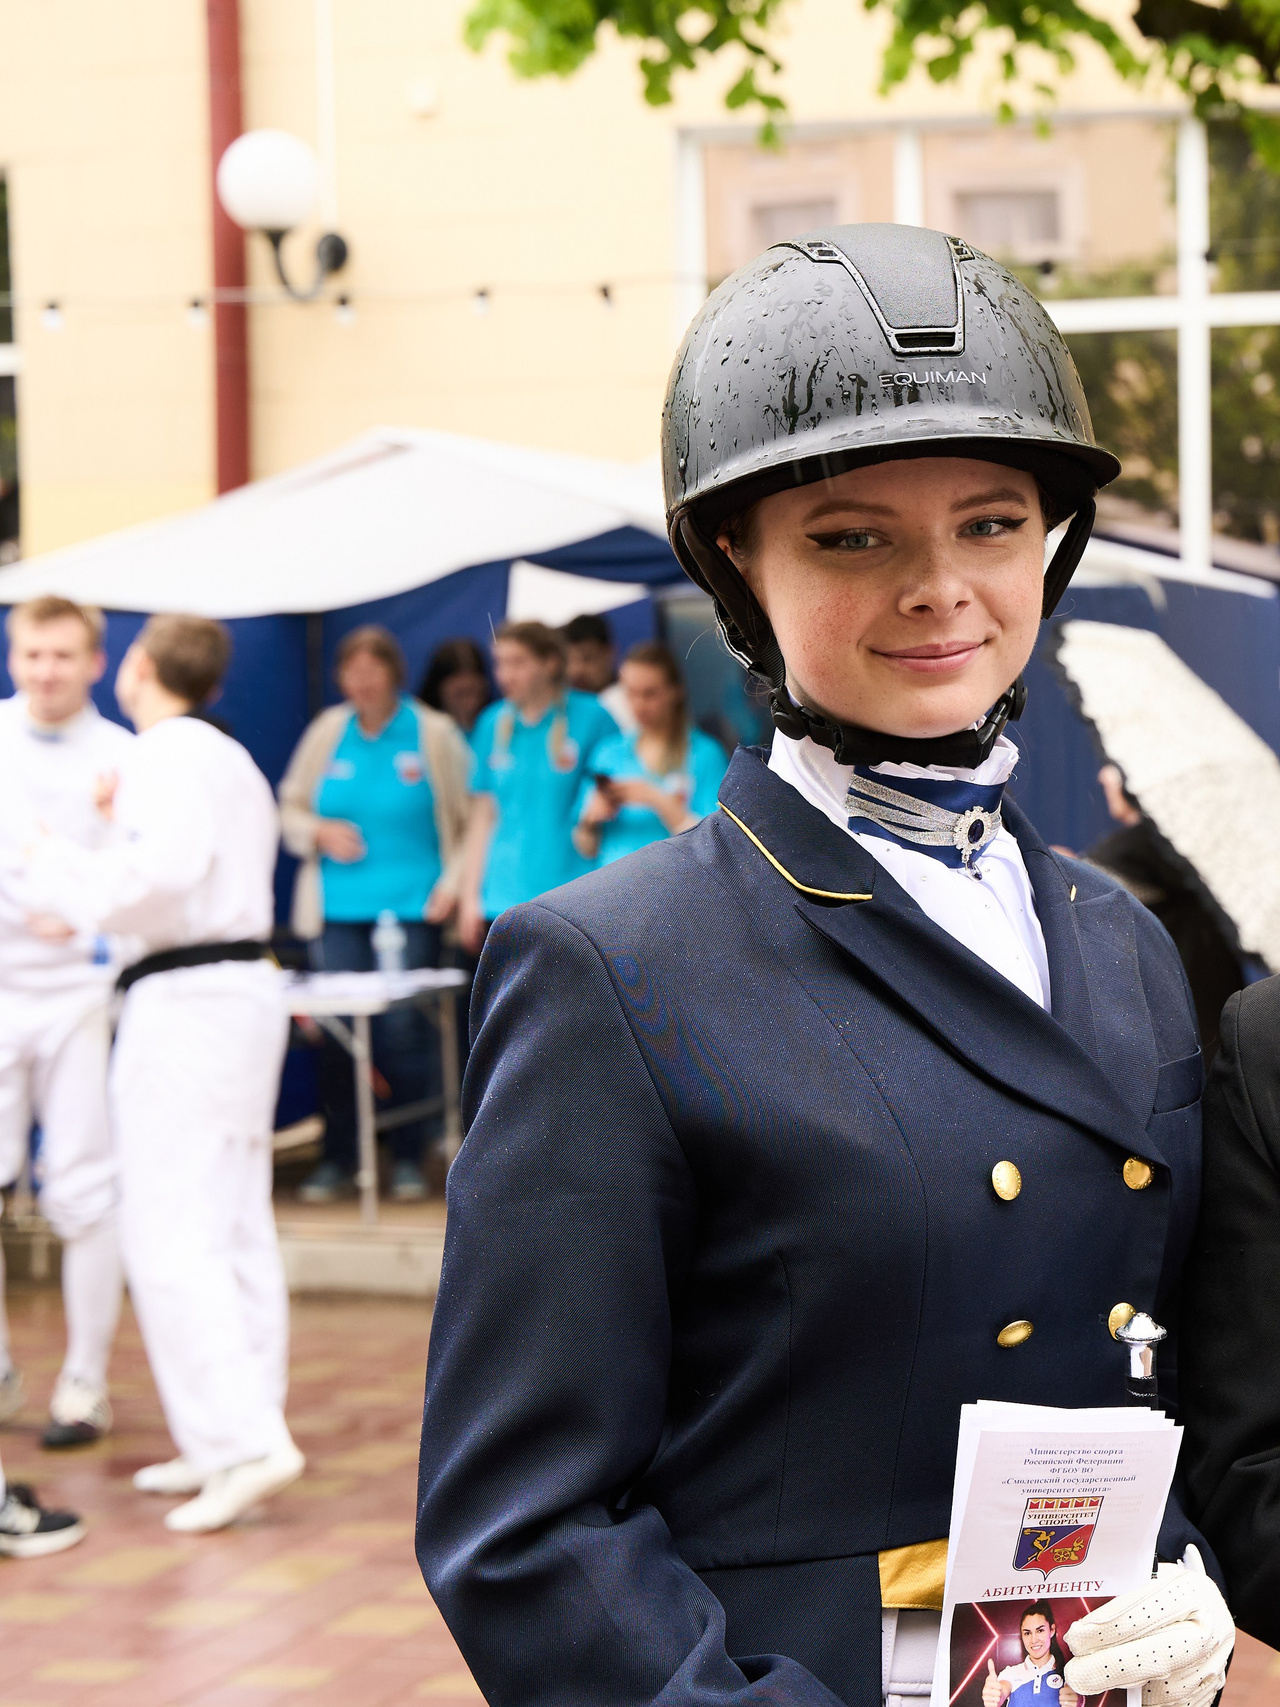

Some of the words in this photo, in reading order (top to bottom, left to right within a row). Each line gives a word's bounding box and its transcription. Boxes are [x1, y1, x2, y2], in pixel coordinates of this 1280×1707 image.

[879, 371, 987, 388] EQUIMAN
[1028, 1447, 1092, 1456] Министерство
[1093, 1448, 1123, 1456] спорта
[1023, 1457, 1073, 1466] Российской
[1075, 1457, 1124, 1466] Федерации
[1002, 1476, 1060, 1485] «Смоленский
[1062, 1474, 1136, 1484] государственный
[1020, 1486, 1075, 1495] университет
[1076, 1486, 1111, 1494] спорта»
[1027, 1511, 1096, 1520] УНИВЕРСИТЕТ
[1038, 1518, 1079, 1526] СПОРТА
[981, 1580, 1104, 1598] АБИТУРИЕНТУ
